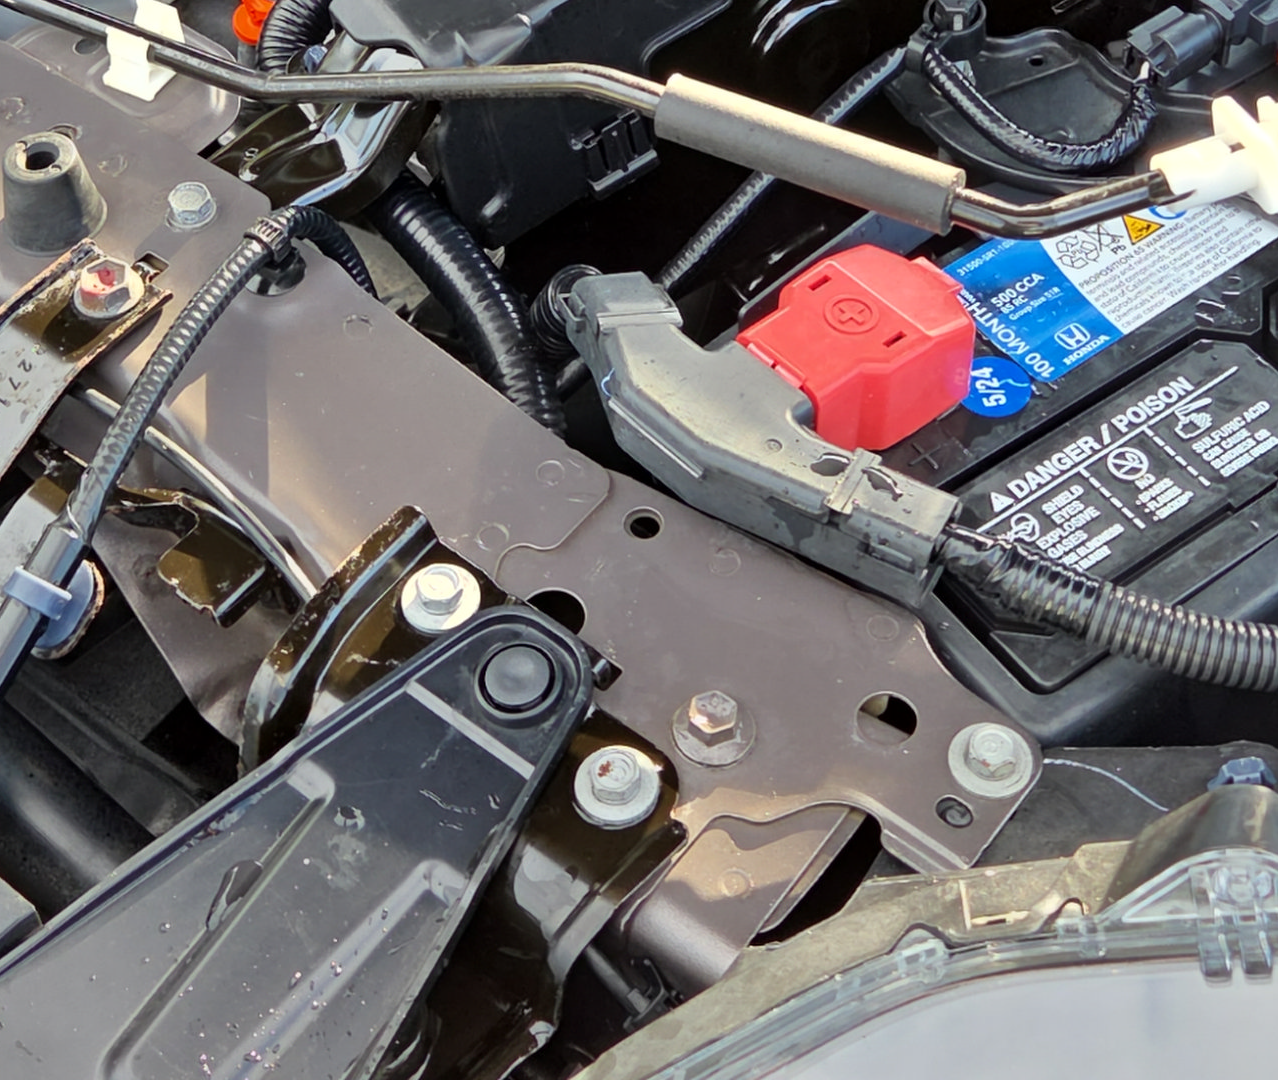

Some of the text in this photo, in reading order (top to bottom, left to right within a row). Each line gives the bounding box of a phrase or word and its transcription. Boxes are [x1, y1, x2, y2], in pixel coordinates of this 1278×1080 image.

[955, 237, 1016, 276] 31500-SR1-100
[1077, 252, 1135, 288] PROPOSITION
[1131, 245, 1145, 255] 65
[1141, 220, 1186, 249] WARNING:
[1110, 242, 1127, 254] Pb
[1117, 263, 1135, 275] and
[989, 286, 1019, 308] 500
[1012, 270, 1045, 293] CCA
[1011, 293, 1028, 306] RC
[1091, 290, 1109, 302] and
[1007, 303, 1033, 322] Group
[1028, 294, 1047, 308] Size
[966, 302, 1055, 377] 100 MONTH
[1061, 332, 1111, 365] HONDA
[970, 367, 1007, 407] 5/24
[1004, 434, 1103, 498] DANGER
[1108, 375, 1196, 433] POISON
[1189, 398, 1273, 453] SULFURIC ACID
[1132, 472, 1157, 489] NO
[1038, 483, 1086, 515] SHIELD
[1048, 498, 1087, 524] EYES
[1033, 505, 1102, 549] EXPLOSIVE
[1044, 528, 1090, 559] GASES
